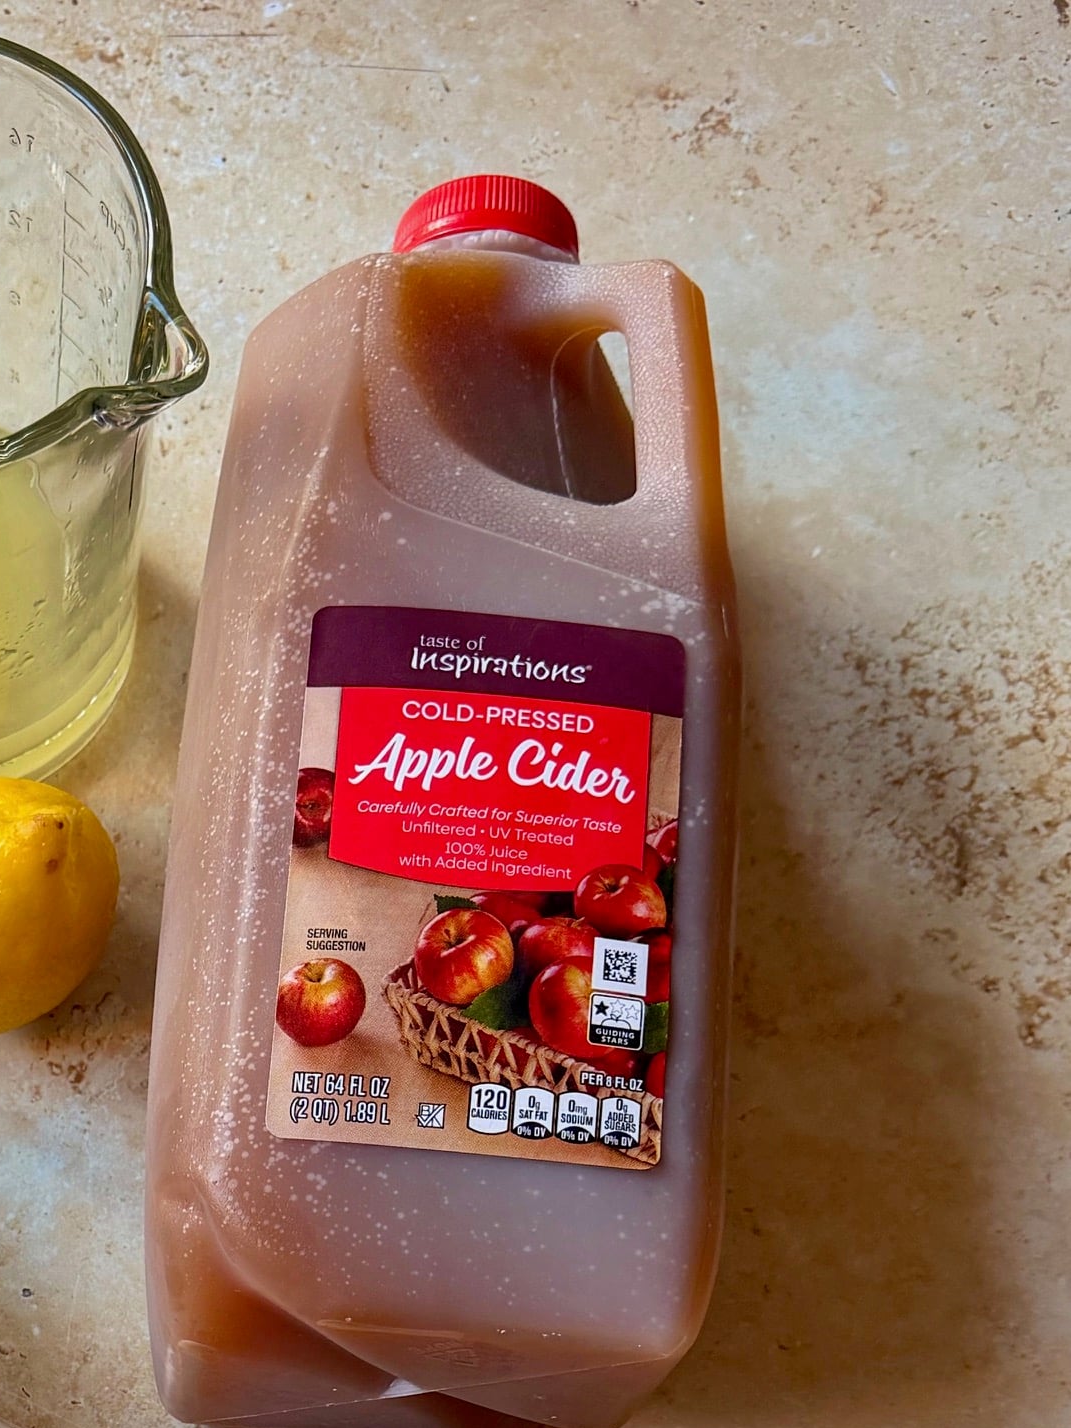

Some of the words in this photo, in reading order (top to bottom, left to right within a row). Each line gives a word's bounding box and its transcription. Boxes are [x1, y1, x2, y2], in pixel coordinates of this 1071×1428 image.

[420, 634, 460, 649] taste
[467, 636, 487, 651] of
[402, 700, 594, 734] COLD-PRESSED
[348, 733, 498, 792] Apple
[507, 739, 635, 804] Cider
[357, 799, 426, 817] Carefully
[428, 803, 488, 820] Crafted
[490, 806, 512, 822] for
[515, 810, 578, 830] Superior
[582, 816, 621, 834] Taste
[402, 821, 476, 837] Unfiltered
[489, 827, 511, 840] UV
[514, 829, 574, 847] Treated
[445, 842, 485, 857] 100%
[488, 845, 528, 860] Juice
[399, 854, 432, 868] with
[435, 857, 487, 872] Added
[491, 860, 572, 880] Ingredient
[307, 928, 348, 939] SERVING
[306, 940, 366, 952] SUGGESTION
[596, 1028, 635, 1039] GUIDING
[601, 1036, 629, 1046] STARS
[292, 1072, 321, 1093] NET
[325, 1074, 345, 1095] 64
[349, 1075, 366, 1097] FL
[370, 1077, 390, 1098] OZ
[581, 1072, 603, 1086] PER
[605, 1075, 613, 1088] 8
[474, 1088, 508, 1110] 120
[528, 1095, 540, 1111] 0g
[568, 1099, 588, 1115] 0mg
[616, 1098, 628, 1114] 0g
[290, 1098, 308, 1123] (2
[311, 1099, 339, 1125] QT)
[344, 1101, 377, 1123] 1.89
[380, 1103, 391, 1125] L
[470, 1107, 508, 1121] CALORIES
[518, 1109, 533, 1120] SAT
[535, 1110, 549, 1121] FAT
[607, 1112, 634, 1124] ADDED
[560, 1113, 593, 1127] SODIUM
[604, 1120, 636, 1133] SUGARS
[517, 1126, 531, 1136] 0%
[534, 1127, 546, 1137] DV
[561, 1130, 576, 1141] 0%
[577, 1131, 590, 1142] DV
[604, 1135, 618, 1146] 0%
[621, 1136, 633, 1147] DV
